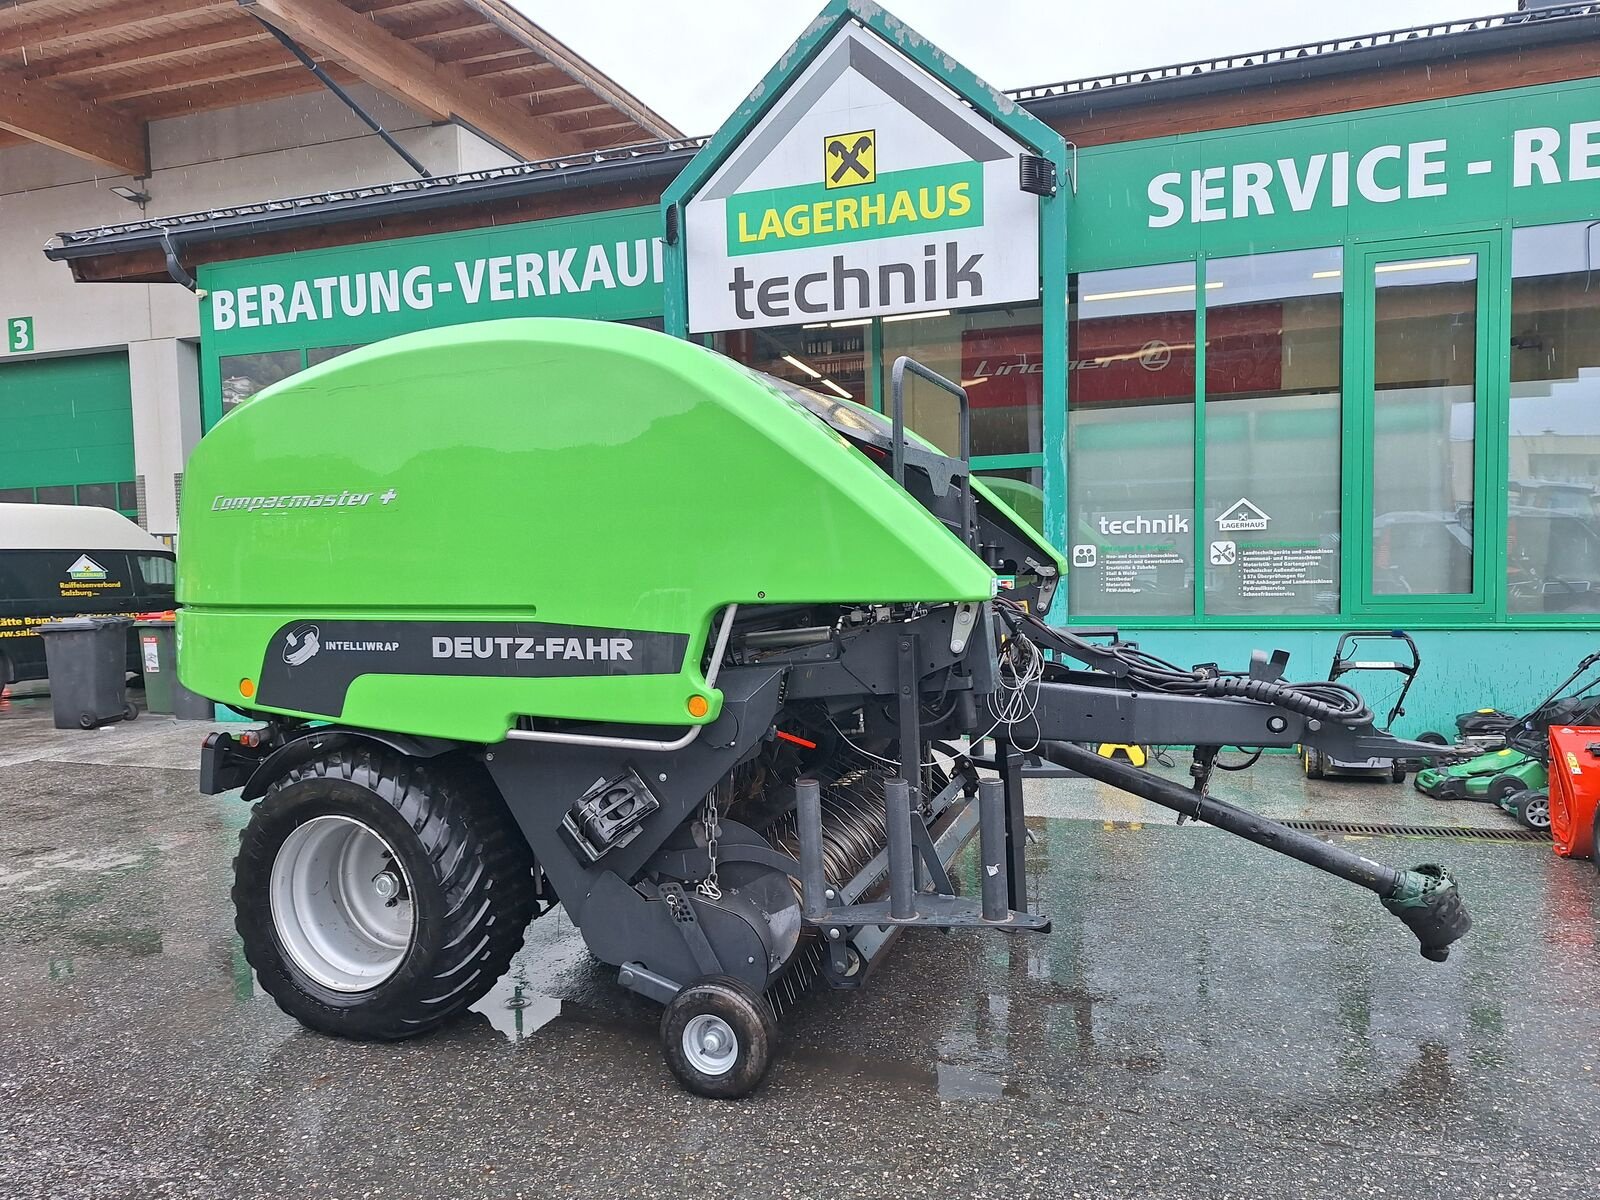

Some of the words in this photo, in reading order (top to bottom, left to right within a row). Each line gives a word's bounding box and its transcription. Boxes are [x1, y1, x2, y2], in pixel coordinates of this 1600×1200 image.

[1146, 138, 1447, 229] SERVICE
[738, 181, 971, 243] LAGERHAUS
[728, 241, 985, 320] technik
[13, 320, 29, 350] 3
[211, 490, 373, 512] Compacmaster
[1098, 514, 1189, 535] technik
[60, 580, 121, 589] Raiffeisenverband
[61, 590, 93, 598] Salzburg
[325, 640, 400, 652] INTELLIWRAP
[432, 636, 634, 661] DEUTZ-FAHR
